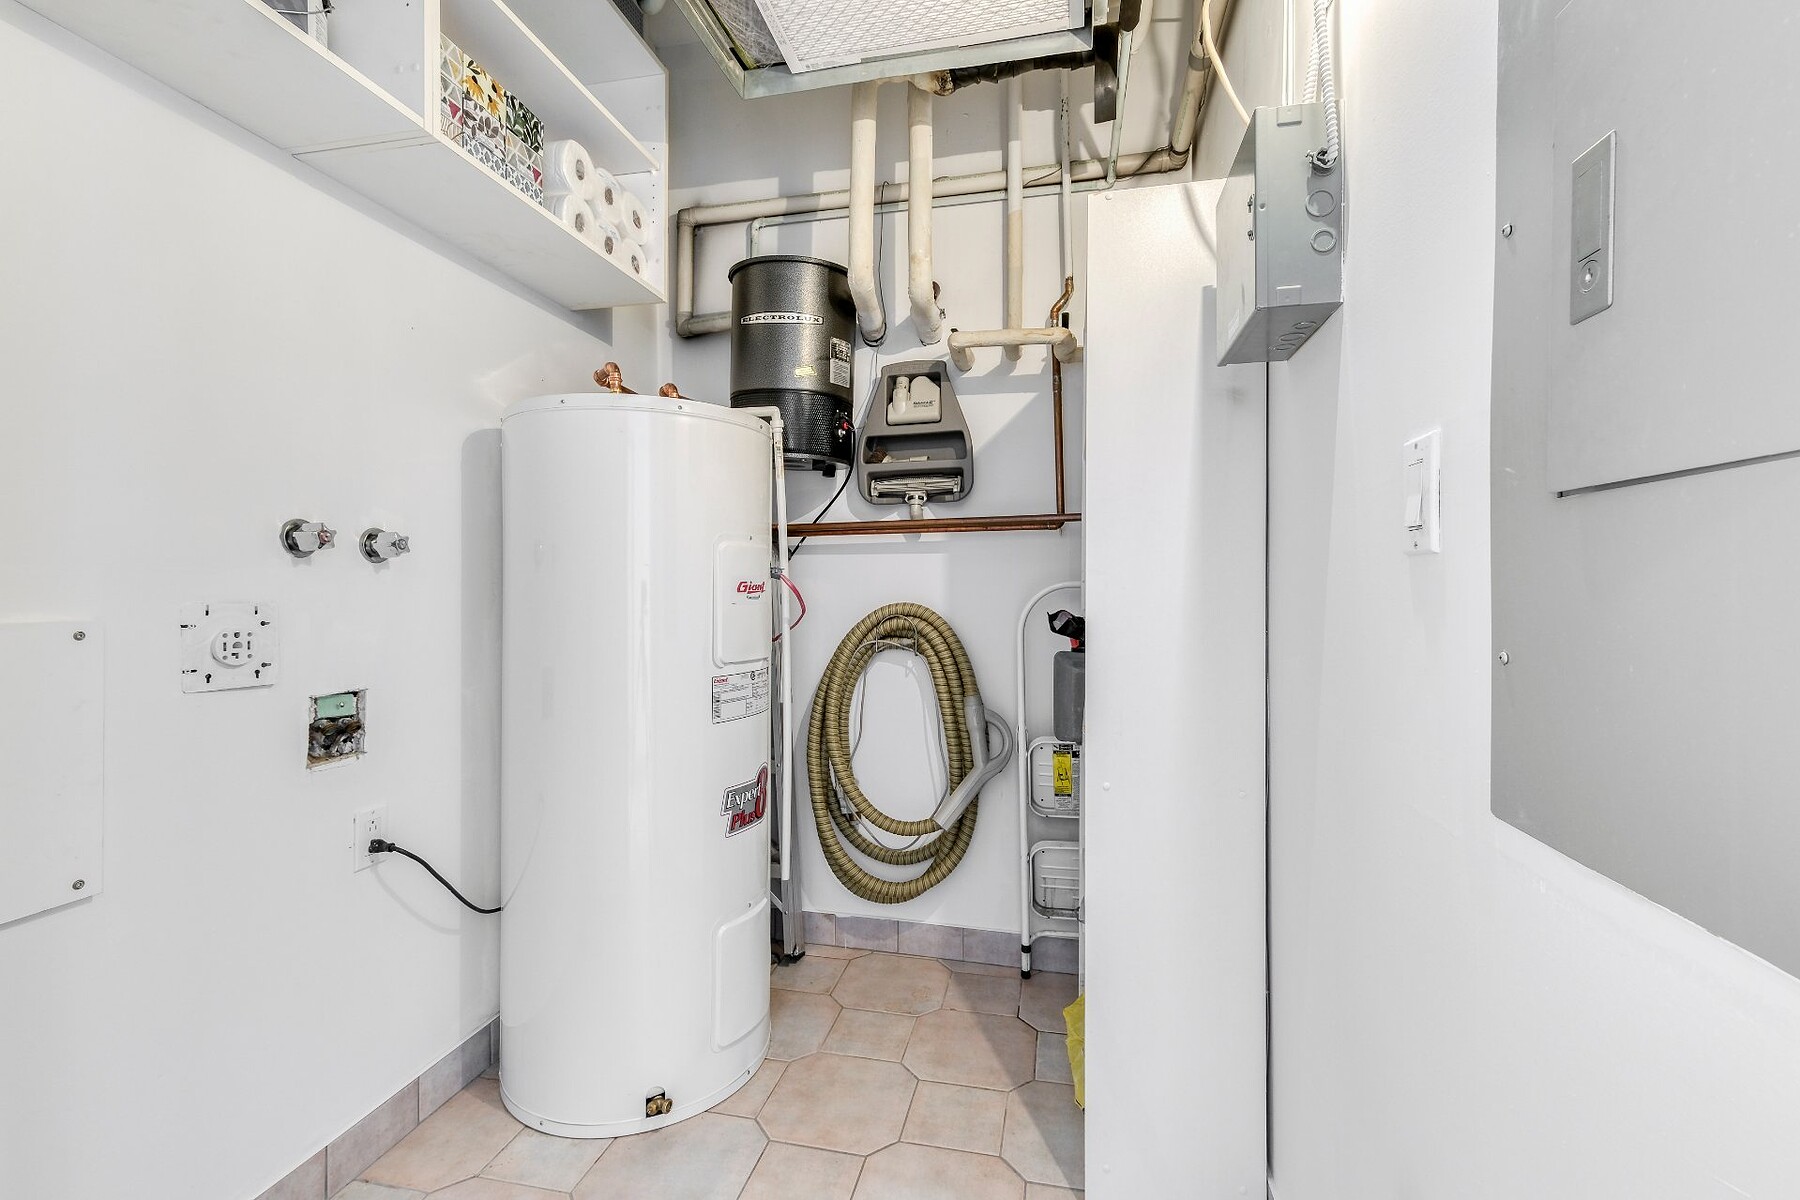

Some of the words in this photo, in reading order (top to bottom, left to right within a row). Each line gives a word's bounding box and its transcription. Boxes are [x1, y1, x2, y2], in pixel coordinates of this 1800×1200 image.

[742, 314, 820, 323] ELECTROLUX
[737, 581, 766, 594] Giant
[727, 783, 761, 810] Expert
[731, 810, 757, 830] Plus
